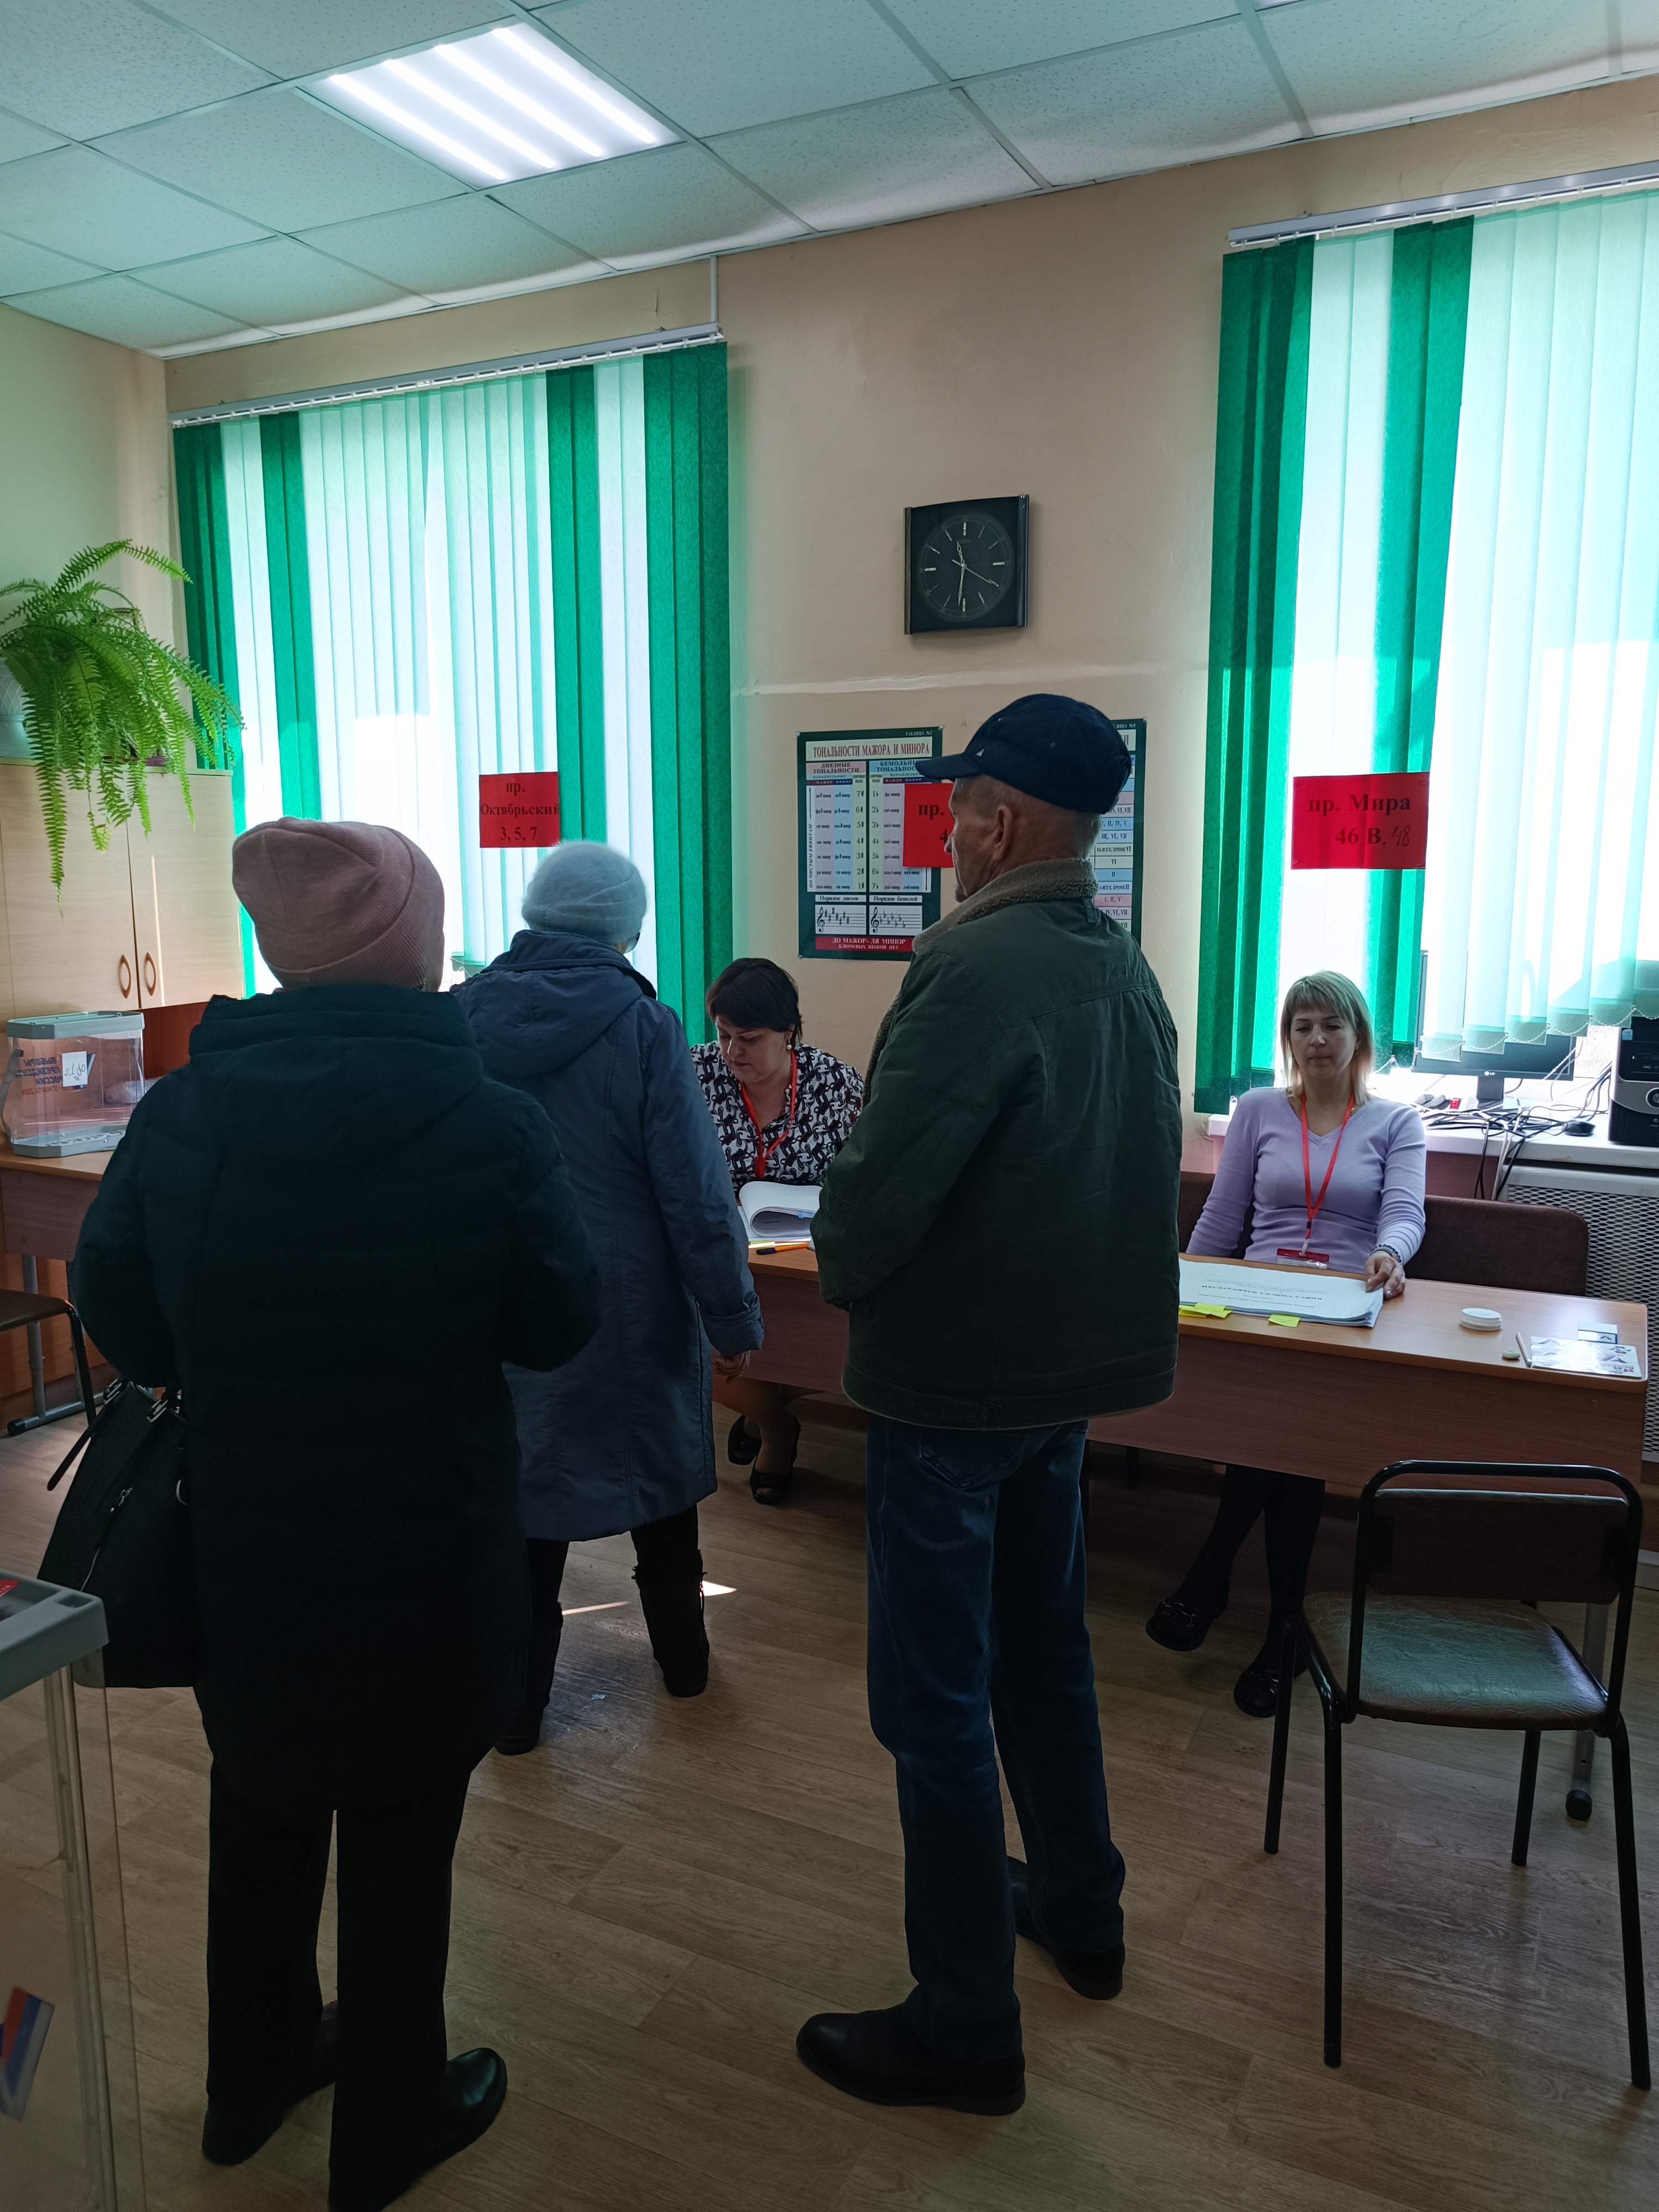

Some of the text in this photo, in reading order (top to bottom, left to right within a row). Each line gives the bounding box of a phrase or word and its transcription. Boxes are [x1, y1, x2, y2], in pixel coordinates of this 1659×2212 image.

[813, 743, 929, 758] ТОНАЛЬНОСТИ МАЖОРА И МИНОРА
[506, 782, 525, 796] пр.
[481, 803, 560, 818] Октябрьский
[919, 805, 945, 820] пр.
[1308, 794, 1410, 816] пр. Мира
[500, 827, 537, 842] 3, 5, 7
[1335, 827, 1359, 844] 46
[1391, 825, 1411, 846] 48
[810, 880, 813, 888] ПО
